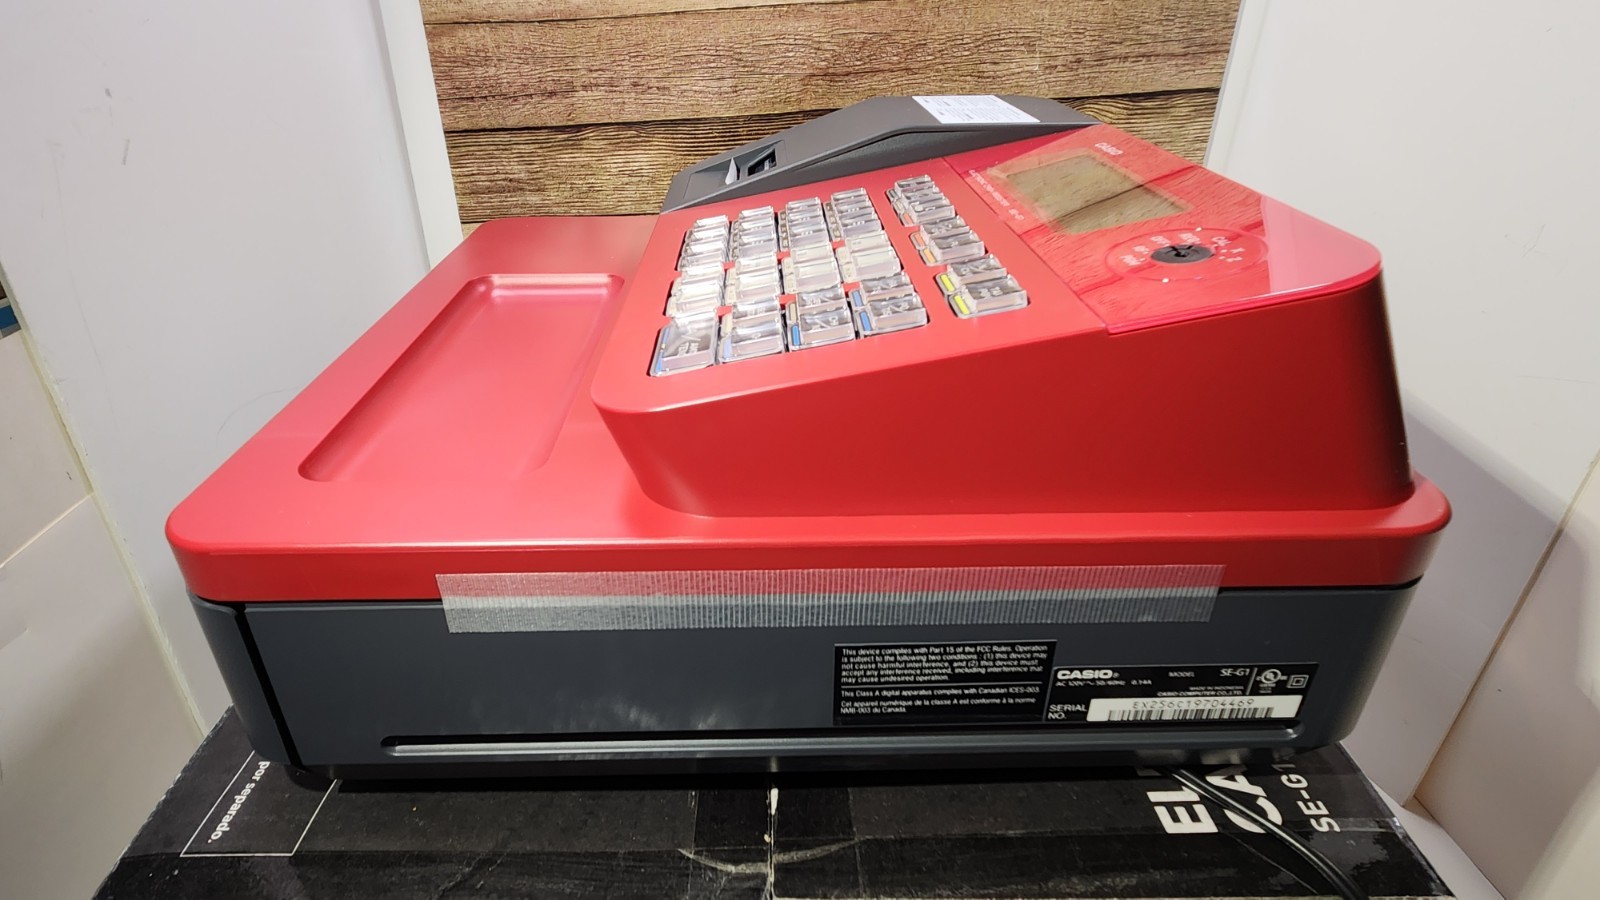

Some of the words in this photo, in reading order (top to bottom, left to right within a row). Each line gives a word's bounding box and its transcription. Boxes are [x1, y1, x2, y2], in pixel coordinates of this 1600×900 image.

[842, 648, 857, 656] This
[858, 647, 880, 655] device
[881, 647, 912, 656] complies
[913, 646, 928, 654] with
[929, 645, 944, 653] Part
[955, 645, 963, 653] of
[964, 645, 975, 653] the
[1014, 644, 1048, 653] Operation
[841, 655, 848, 663] is
[849, 655, 874, 663] subject
[896, 654, 927, 662] following
[928, 653, 941, 661] two
[983, 652, 994, 660] (1)
[995, 652, 1008, 660] this
[1009, 652, 1031, 660] device
[1032, 652, 1048, 660] may
[877, 661, 905, 669] harmful
[967, 659, 979, 667] (2)
[980, 659, 994, 667] this
[994, 659, 1018, 667] device
[841, 669, 865, 677] accept
[880, 668, 920, 676] interference
[986, 665, 1029, 673] interference
[1220, 667, 1250, 677] SE-G1
[841, 676, 856, 684] may
[857, 675, 879, 683] cause
[880, 675, 914, 683] undesired
[841, 689, 855, 698] This
[855, 689, 873, 697] Class
[874, 689, 880, 697] A
[880, 689, 900, 698] digital
[901, 689, 932, 697] apparatus
[933, 687, 962, 695] complies
[978, 686, 1008, 694] Canadian
[841, 700, 852, 708] Cet
[853, 700, 878, 708] appareil
[879, 699, 913, 707] numérique
[930, 698, 951, 706] classe
[970, 697, 1001, 705] conforme
[1049, 703, 1087, 713] SERIAL
[1047, 712, 1067, 721] NO.
[251, 760, 271, 782] por
[1271, 763, 1341, 833] SE-G1
[207, 782, 256, 844] separado.
